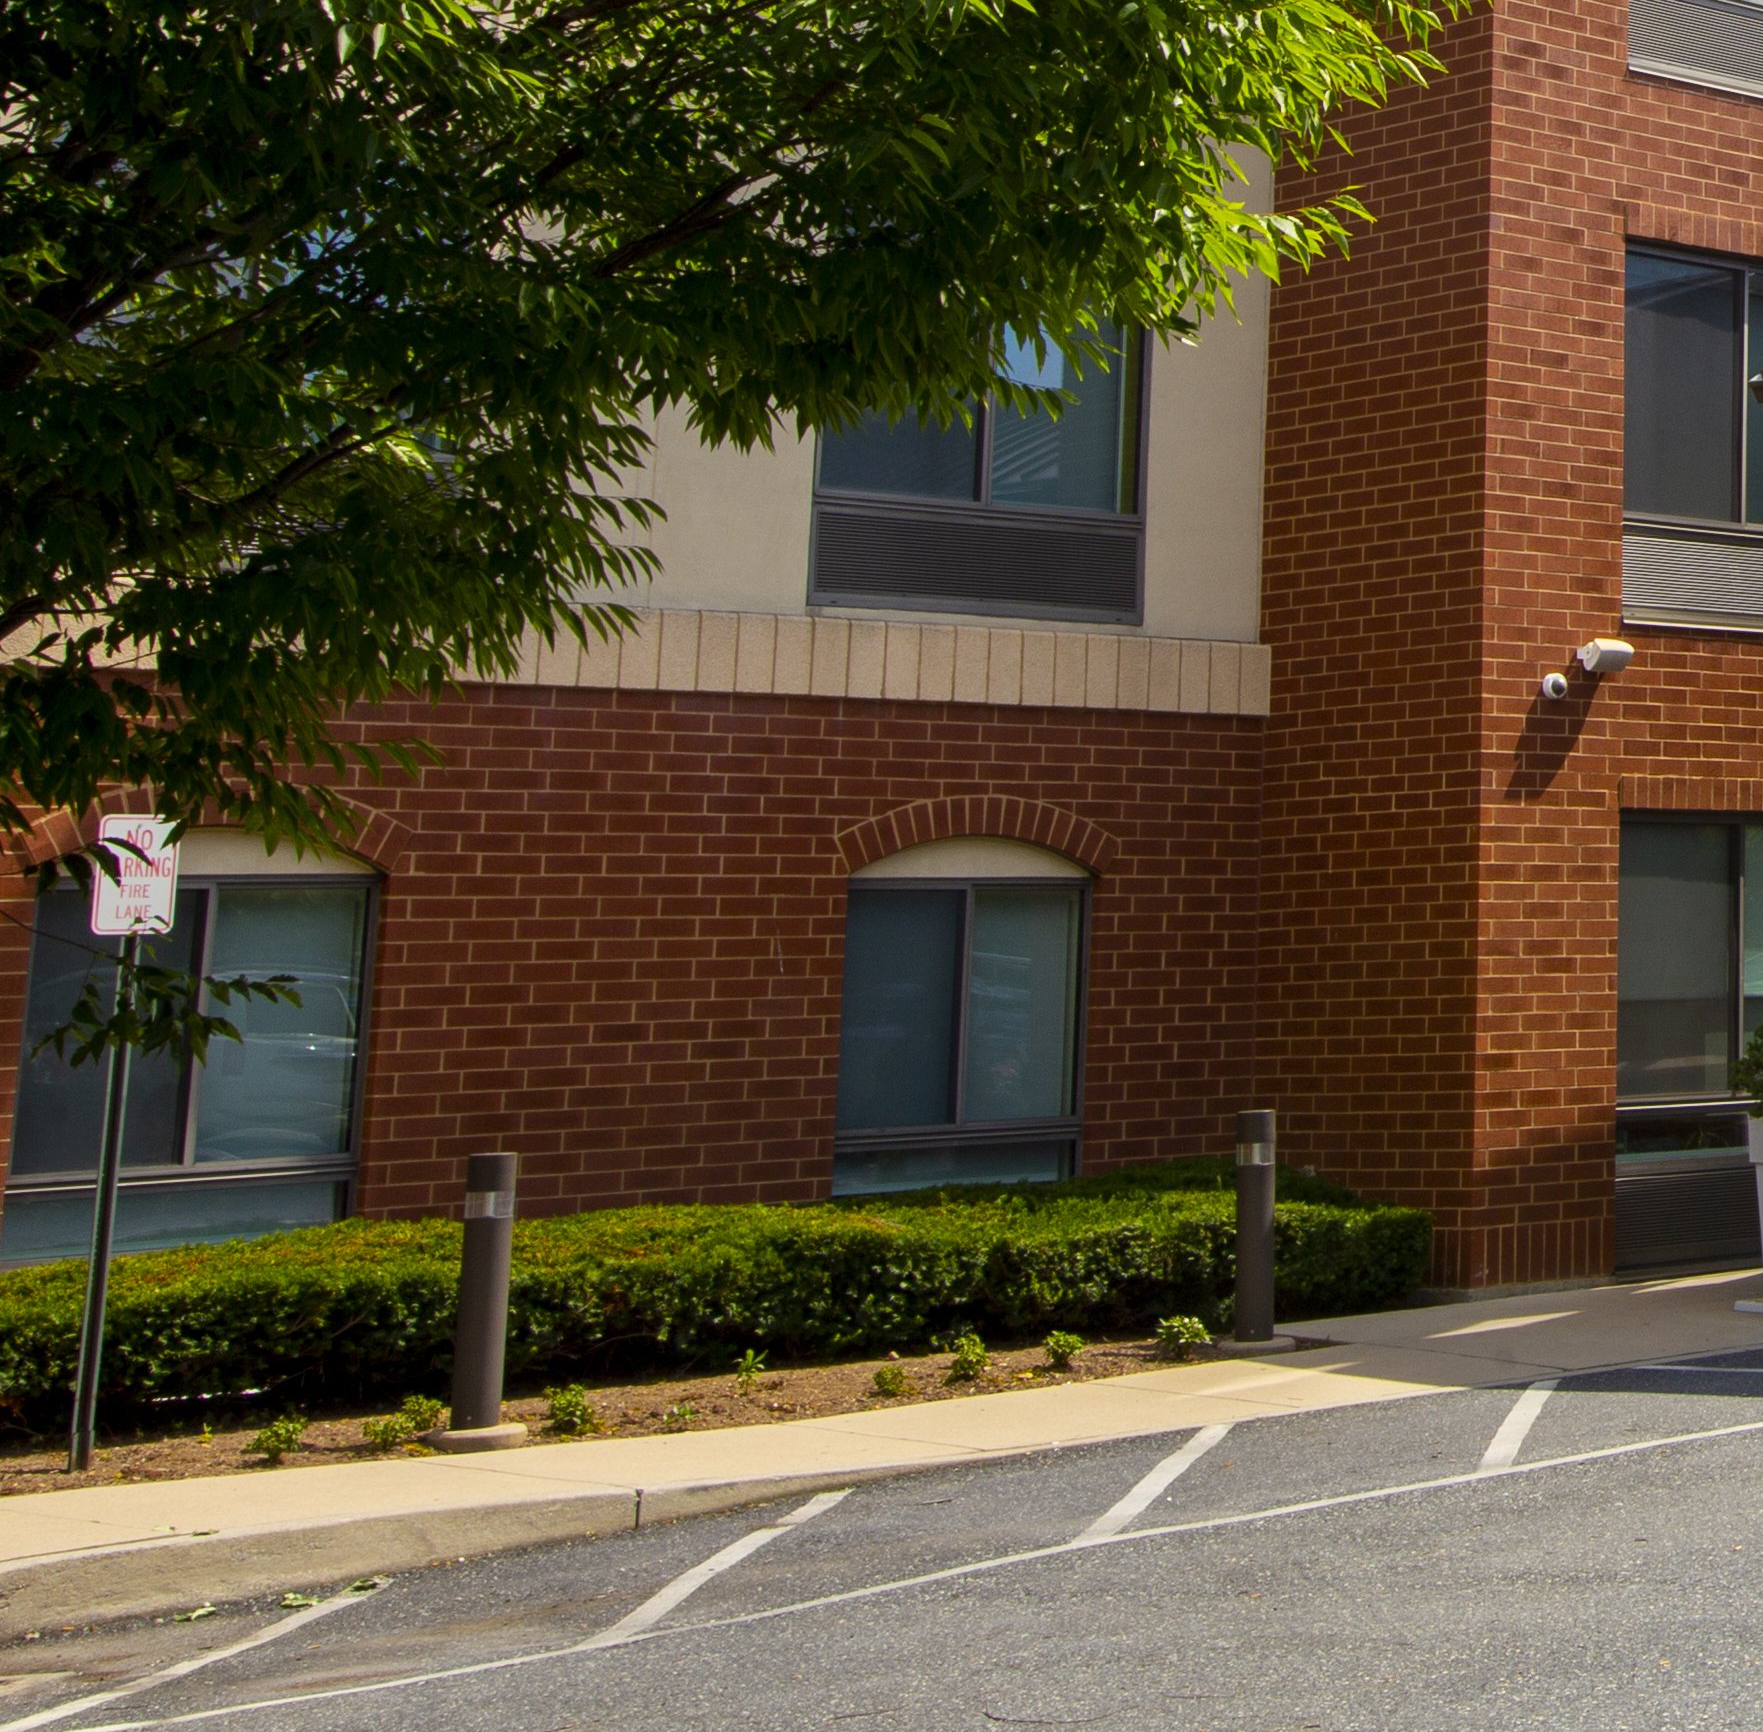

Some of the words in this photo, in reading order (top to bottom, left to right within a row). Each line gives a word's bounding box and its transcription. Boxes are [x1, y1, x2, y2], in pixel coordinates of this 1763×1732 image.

[126, 829, 154, 851] NO
[103, 856, 171, 879] RKING
[120, 884, 151, 898] FIRE
[115, 905, 152, 919] LANE
